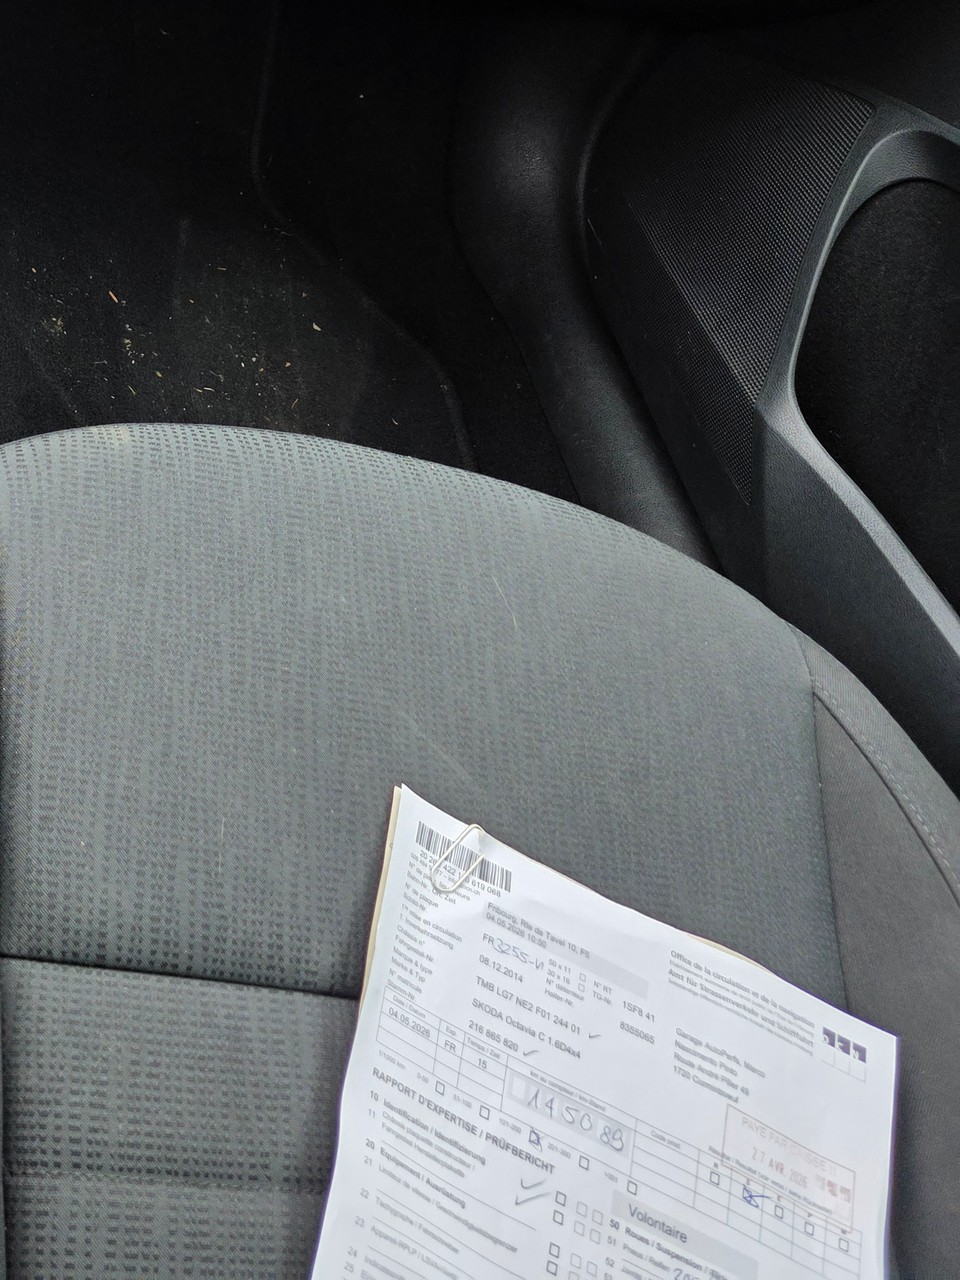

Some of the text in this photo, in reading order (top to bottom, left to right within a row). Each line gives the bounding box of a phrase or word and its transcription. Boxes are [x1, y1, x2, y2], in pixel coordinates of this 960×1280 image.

[442, 863, 456, 876] 422
[471, 878, 485, 891] 619
[486, 885, 501, 897] 068
[419, 892, 438, 909] plaque
[487, 901, 518, 924] Fribourg,
[431, 921, 462, 943] circulation
[478, 953, 523, 983] 08.12.2014
[670, 949, 692, 966] Office
[471, 997, 503, 1020] SKODA
[504, 1014, 536, 1037] Octavia
[475, 975, 494, 992] TMB
[496, 985, 513, 1002] LG7
[515, 995, 533, 1012] NE2
[535, 1005, 551, 1020] F01
[552, 1014, 568, 1029] 244
[387, 1006, 431, 1038] 04.05.2026
[468, 1019, 518, 1052] 216 865 820
[619, 1020, 655, 1044] 8355065
[372, 1066, 555, 1175] RAPPORT D'EXPERTISE PRÜFBERICHT
[383, 1098, 429, 1132] Identification
[627, 1202, 688, 1245] Volontaire
[624, 1226, 702, 1272] Roues Suspension
